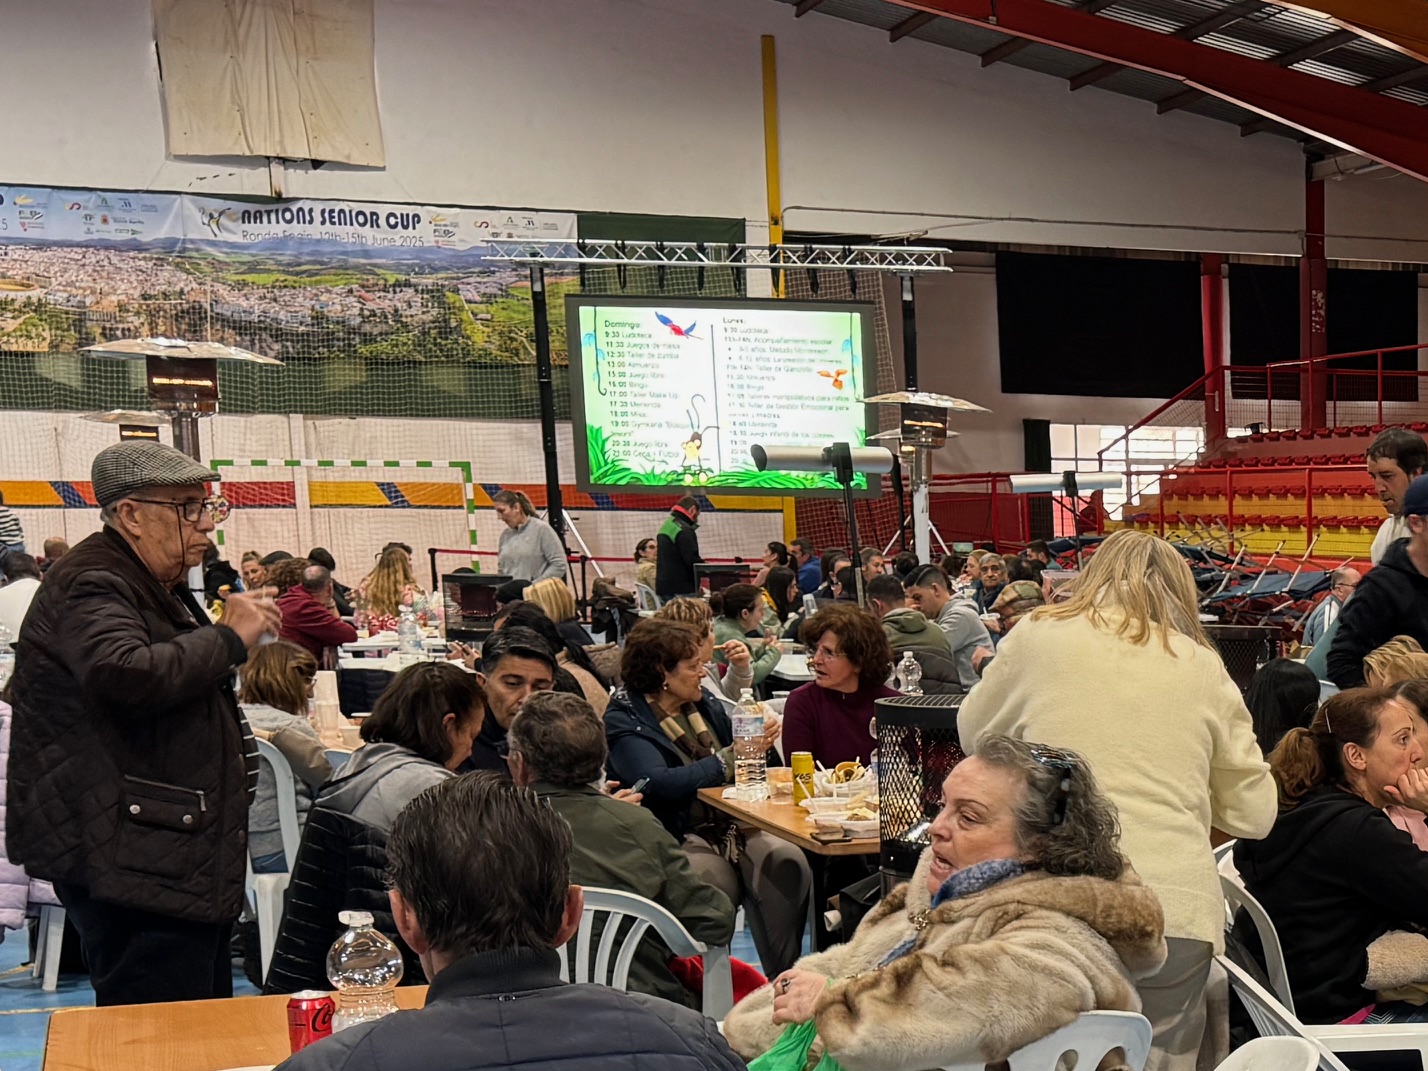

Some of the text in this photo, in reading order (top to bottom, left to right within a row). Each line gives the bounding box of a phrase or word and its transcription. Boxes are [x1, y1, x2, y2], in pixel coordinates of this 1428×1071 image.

[241, 206, 422, 231] NATIONS SENIOR CUP
[370, 233, 397, 247] June
[399, 235, 425, 248] 2025
